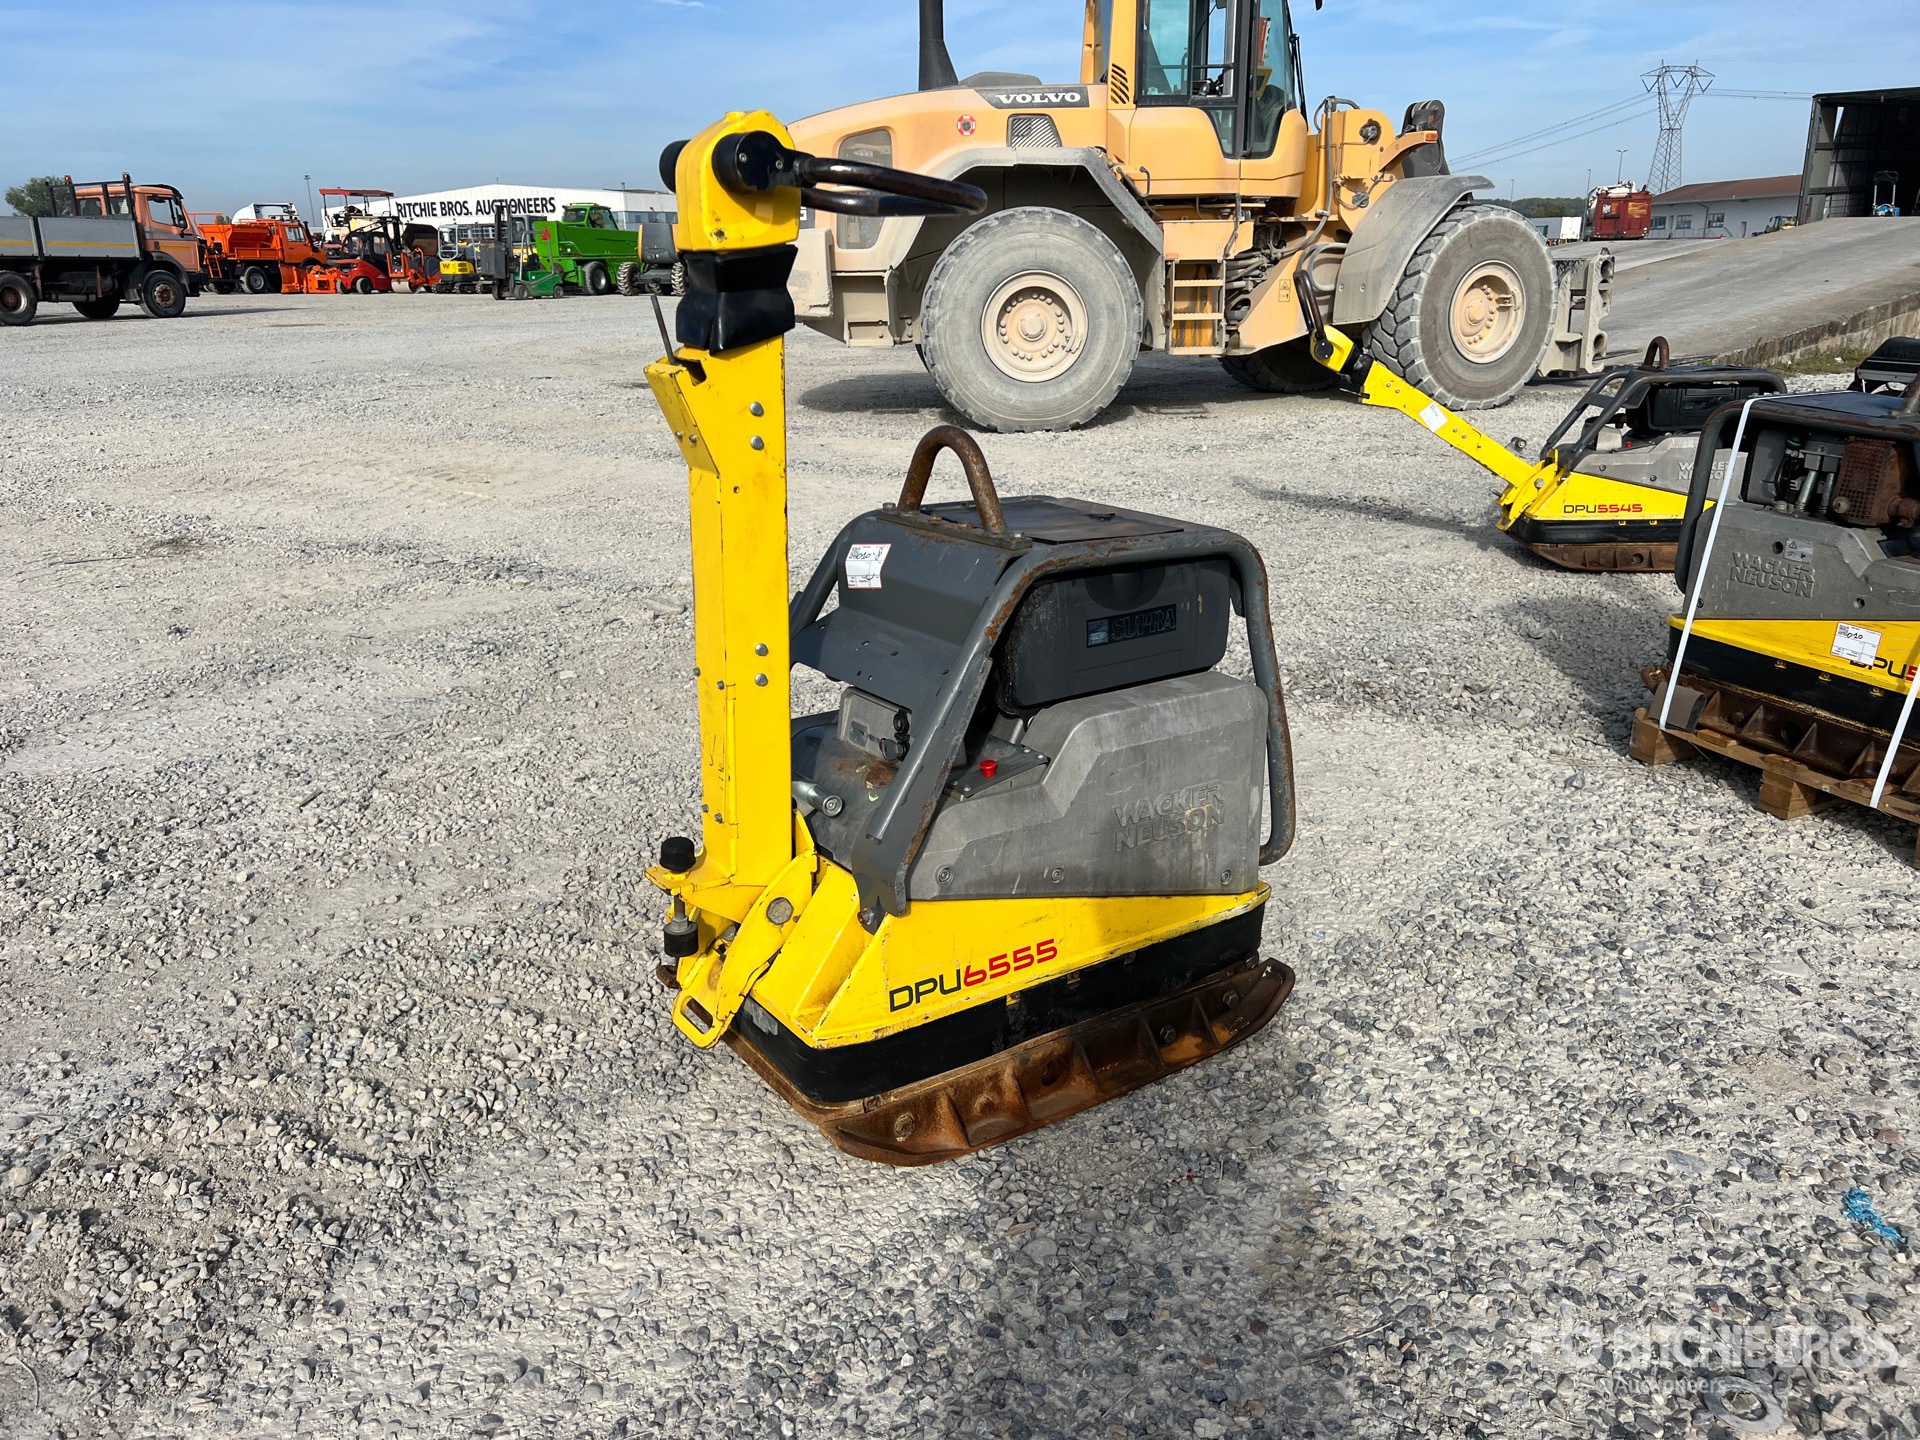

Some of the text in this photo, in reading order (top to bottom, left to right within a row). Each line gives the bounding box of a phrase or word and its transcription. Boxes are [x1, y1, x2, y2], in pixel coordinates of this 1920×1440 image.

[995, 92, 1081, 104] VOLVO
[397, 202, 438, 218] RITCHIE
[440, 200, 473, 216] BROS.
[1563, 503, 1643, 514] DPU5545
[1730, 567, 1815, 598] NEUSON
[1731, 552, 1816, 583] WACKER
[1111, 608, 1176, 640] SUPRA
[1112, 780, 1225, 827] WACKER
[1114, 803, 1225, 852] NEUSON
[889, 938, 1058, 1013] DPU6555
